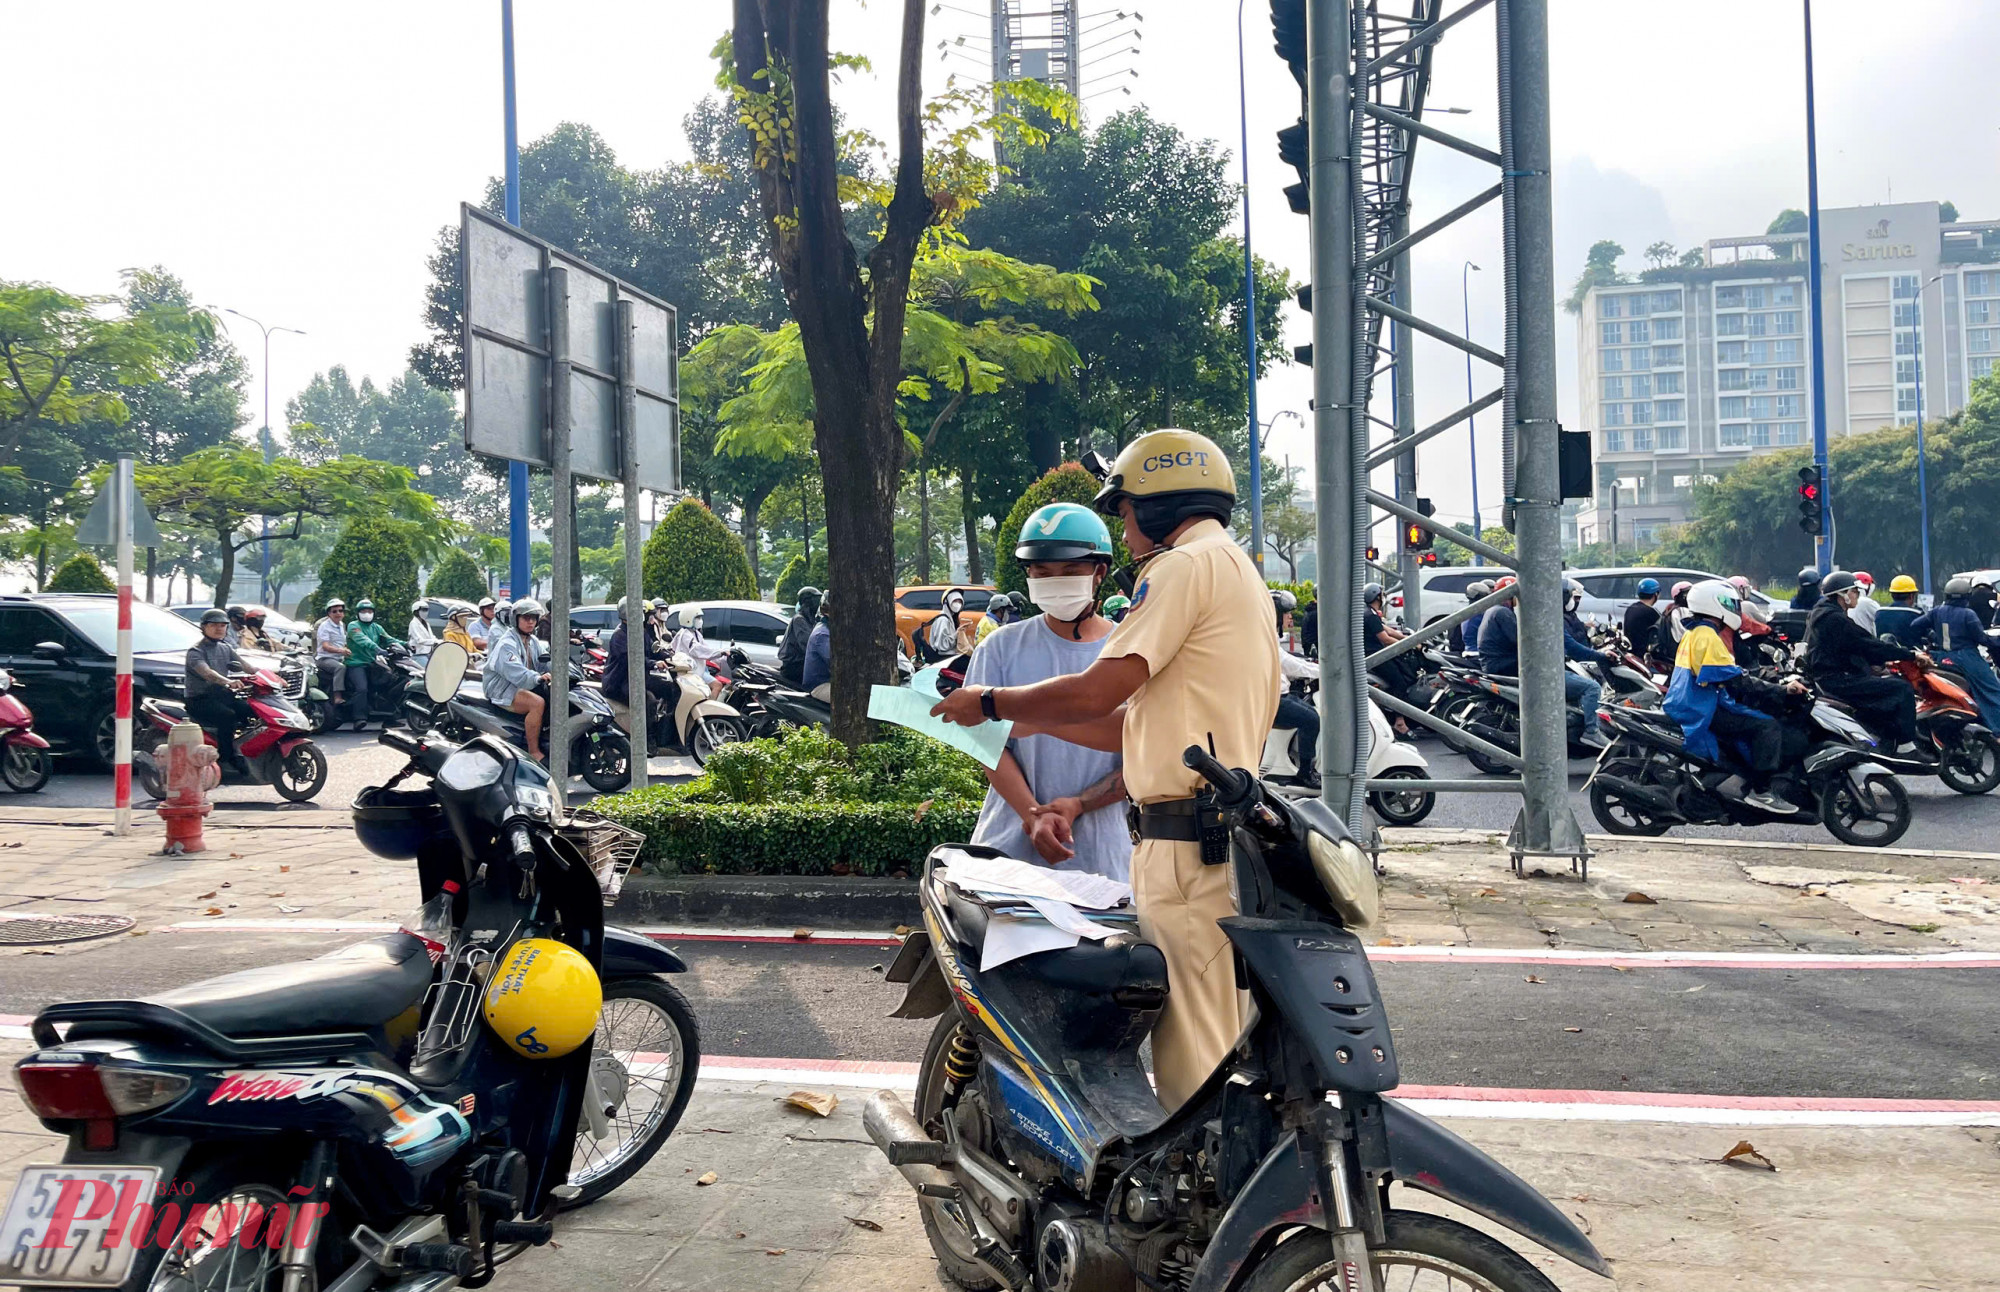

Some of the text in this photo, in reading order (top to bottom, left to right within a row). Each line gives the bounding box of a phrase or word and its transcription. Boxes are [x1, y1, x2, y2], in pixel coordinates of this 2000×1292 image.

[1143, 451, 1209, 473] CSGT
[937, 937, 979, 999] Wave
[515, 1026, 549, 1055] be
[207, 1072, 308, 1106] Wave
[1016, 1112, 1051, 1138] STROKE
[10, 1227, 120, 1276] 6075
